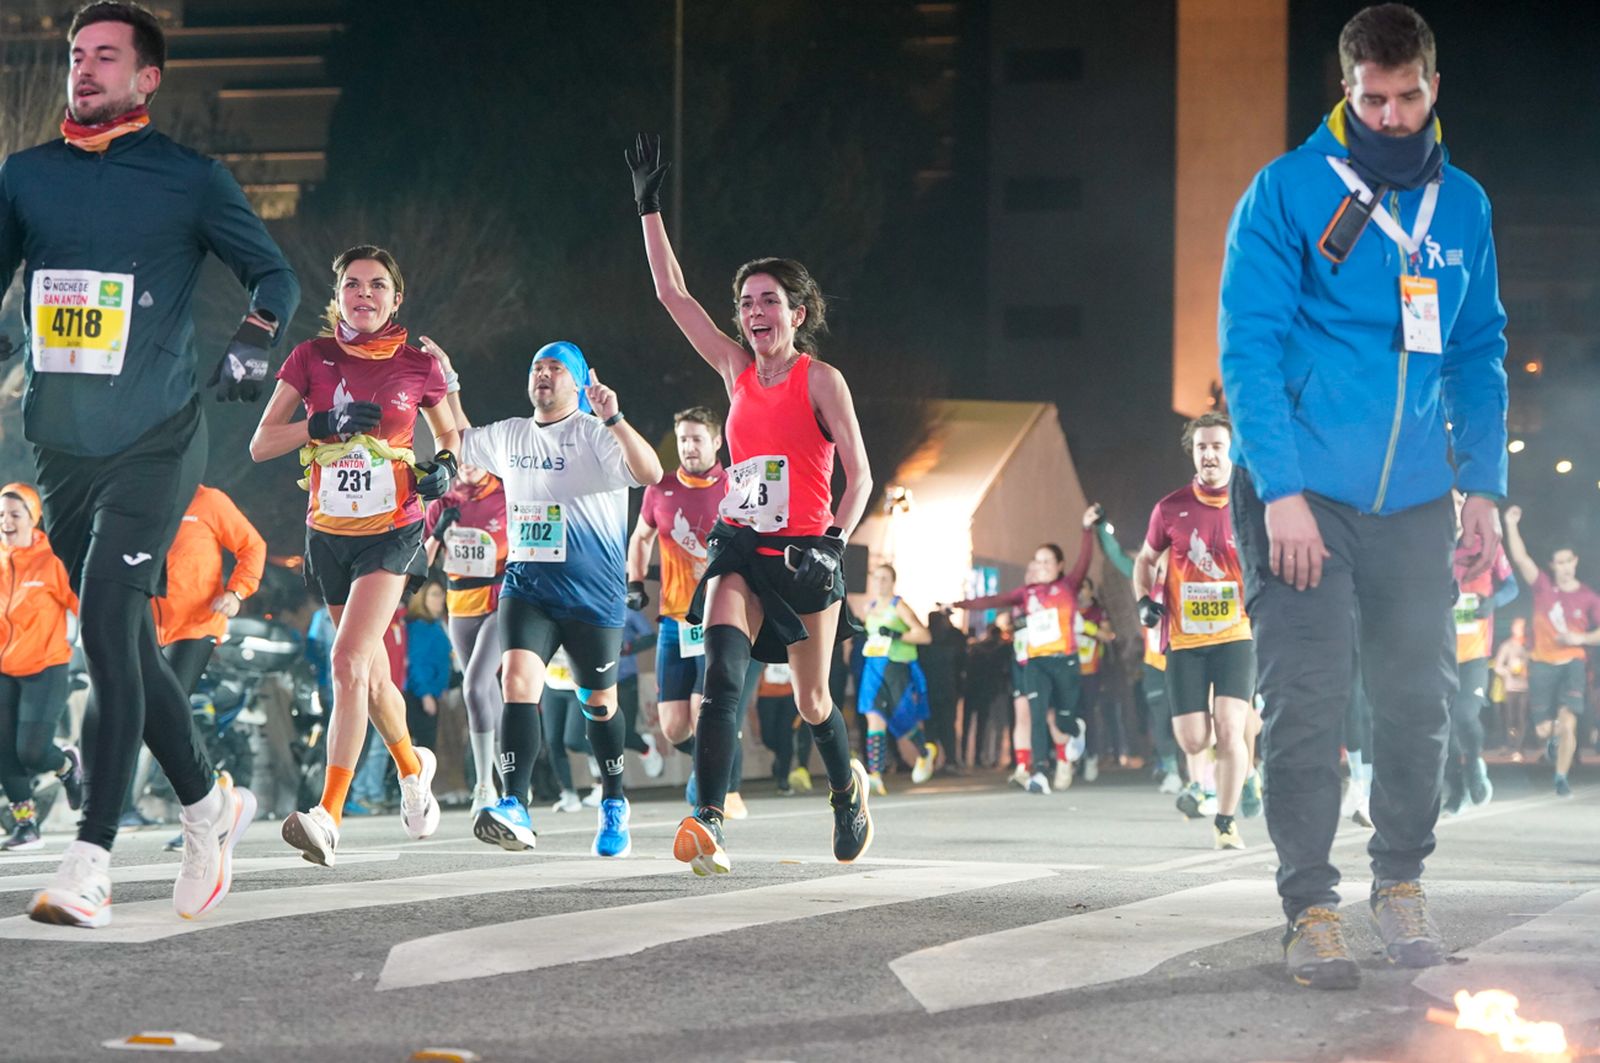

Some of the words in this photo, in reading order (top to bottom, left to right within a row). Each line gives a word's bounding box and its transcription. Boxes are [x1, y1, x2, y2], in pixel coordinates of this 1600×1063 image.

[53, 282, 77, 292] NOCHE
[43, 294, 58, 305] SAN
[52, 308, 103, 338] 4718
[337, 469, 371, 492] 231
[738, 482, 768, 510] 23
[520, 523, 552, 541] 2702
[454, 545, 485, 560] 6318
[1191, 601, 1229, 616] 3838
